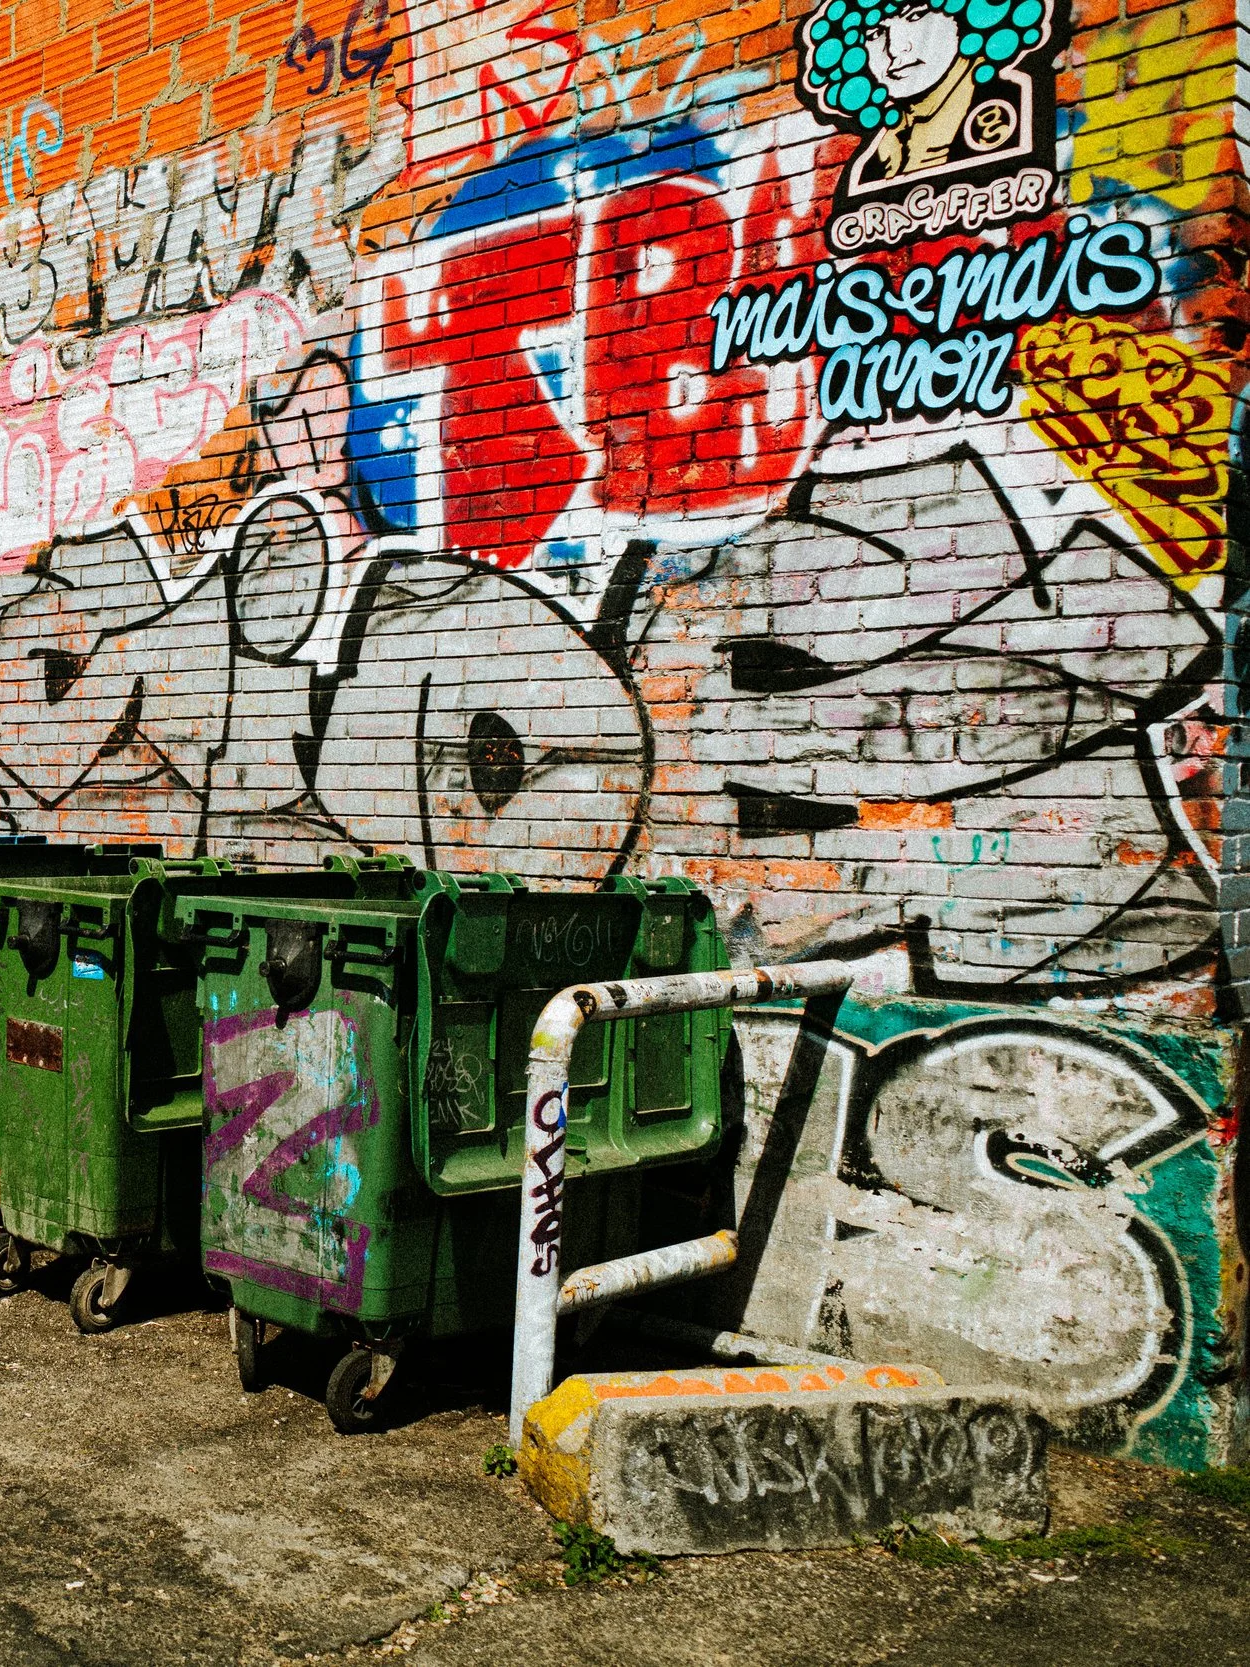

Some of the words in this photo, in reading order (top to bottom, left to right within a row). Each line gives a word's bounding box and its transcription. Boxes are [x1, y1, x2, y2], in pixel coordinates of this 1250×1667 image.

[832, 169, 1052, 250] GRACIFFER
[710, 262, 888, 371] mais
[886, 269, 938, 317] e
[935, 216, 1157, 334] mais
[818, 327, 1014, 423] amor
[530, 1089, 567, 1278] OLHOS
